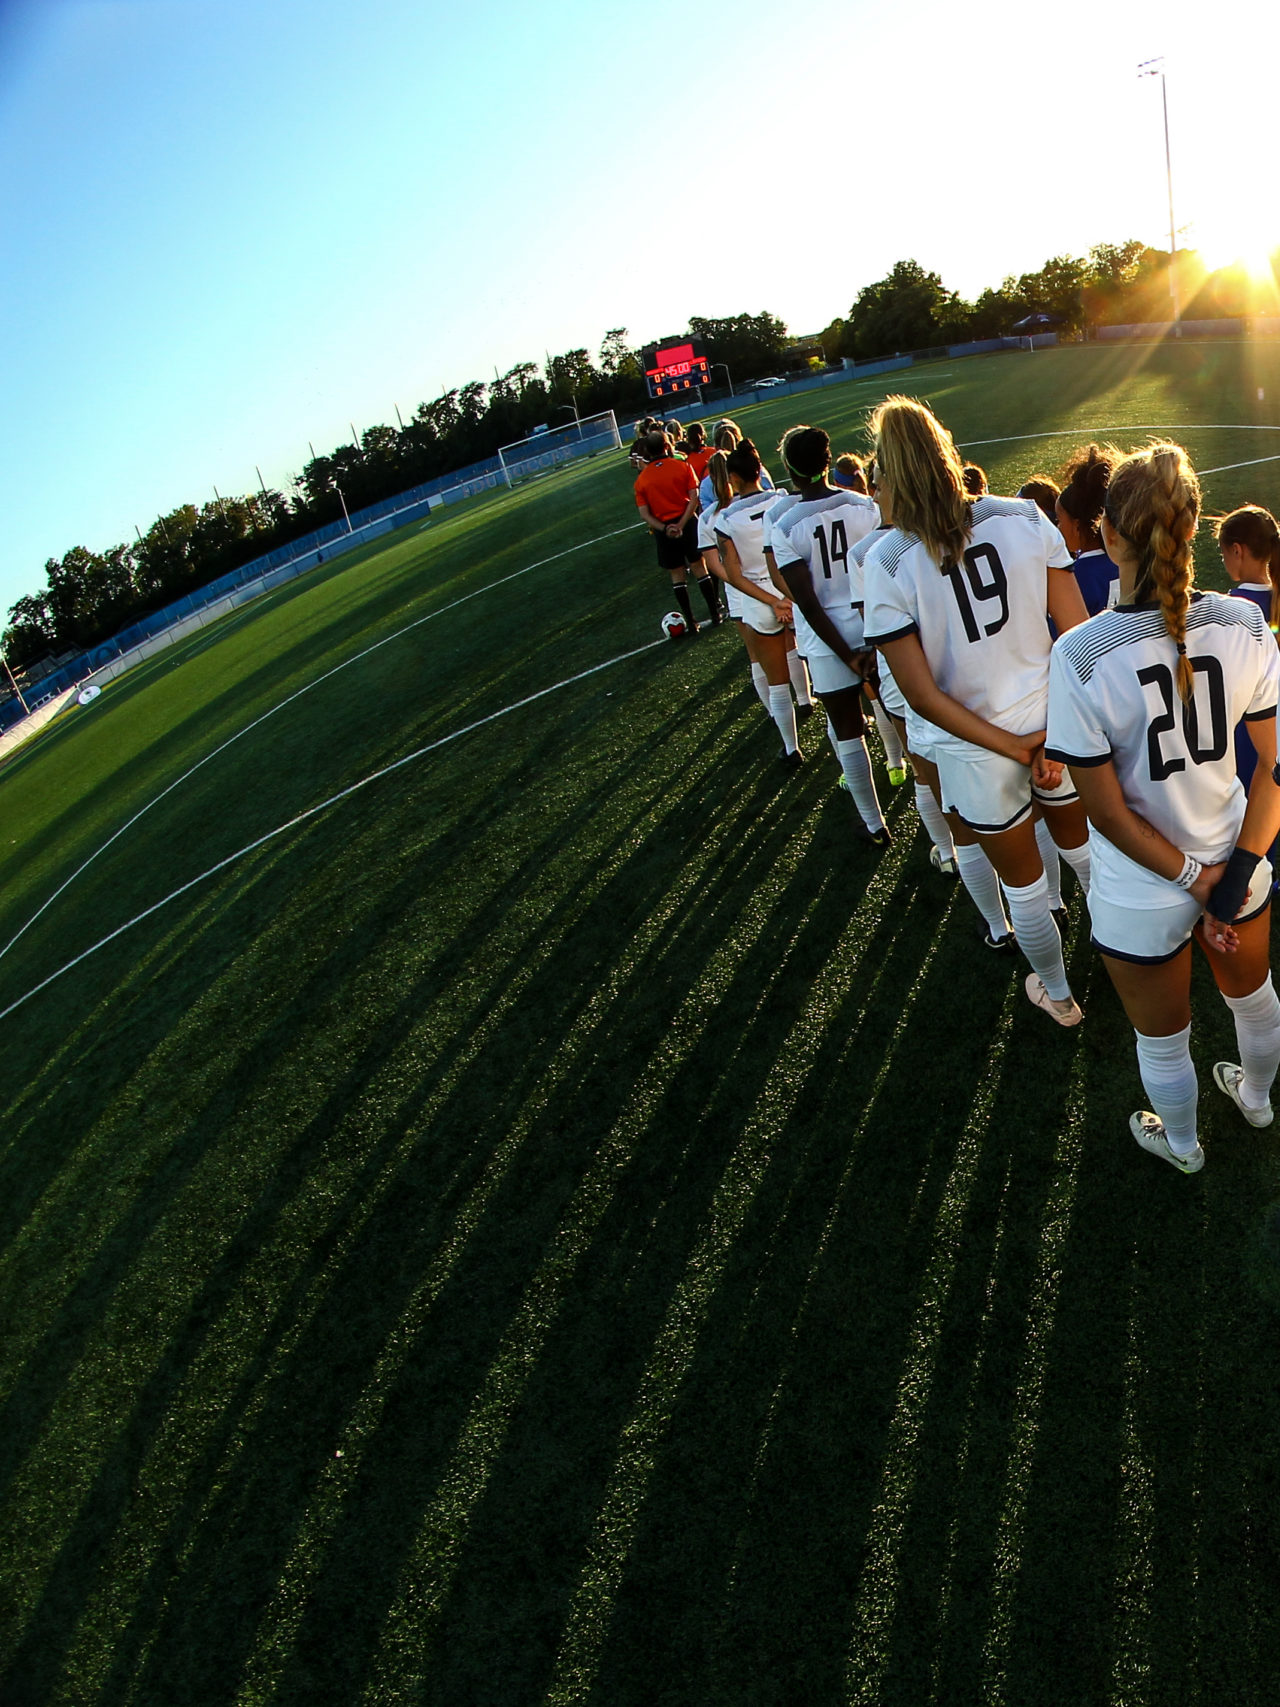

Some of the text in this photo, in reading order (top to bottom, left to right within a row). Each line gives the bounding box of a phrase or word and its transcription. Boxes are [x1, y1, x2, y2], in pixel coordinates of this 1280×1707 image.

[813, 519, 848, 579] 14
[941, 542, 1009, 643] 19
[1136, 655, 1228, 781] 20
